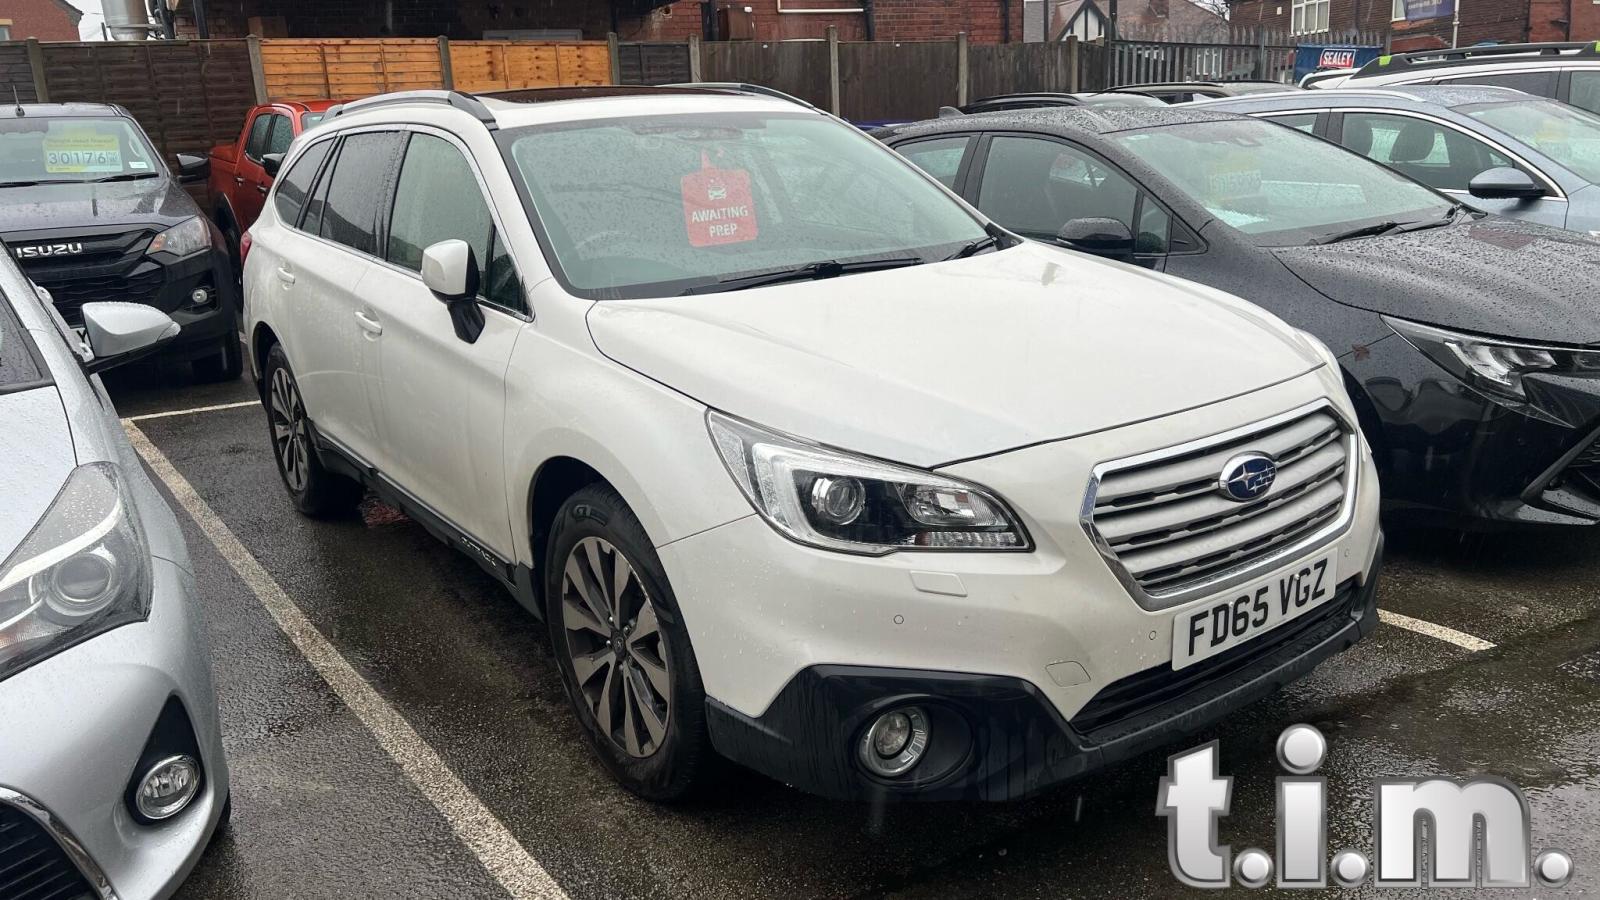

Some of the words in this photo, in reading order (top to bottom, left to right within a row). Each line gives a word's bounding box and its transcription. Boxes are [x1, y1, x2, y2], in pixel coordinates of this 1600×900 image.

[1323, 51, 1352, 65] SEALEY
[48, 152, 106, 165] 30176
[692, 205, 748, 223] AWAITING
[709, 223, 737, 237] PREP
[16, 242, 82, 258] ISUZU
[1188, 586, 1269, 656] FD65
[1280, 558, 1328, 615] VGZ
